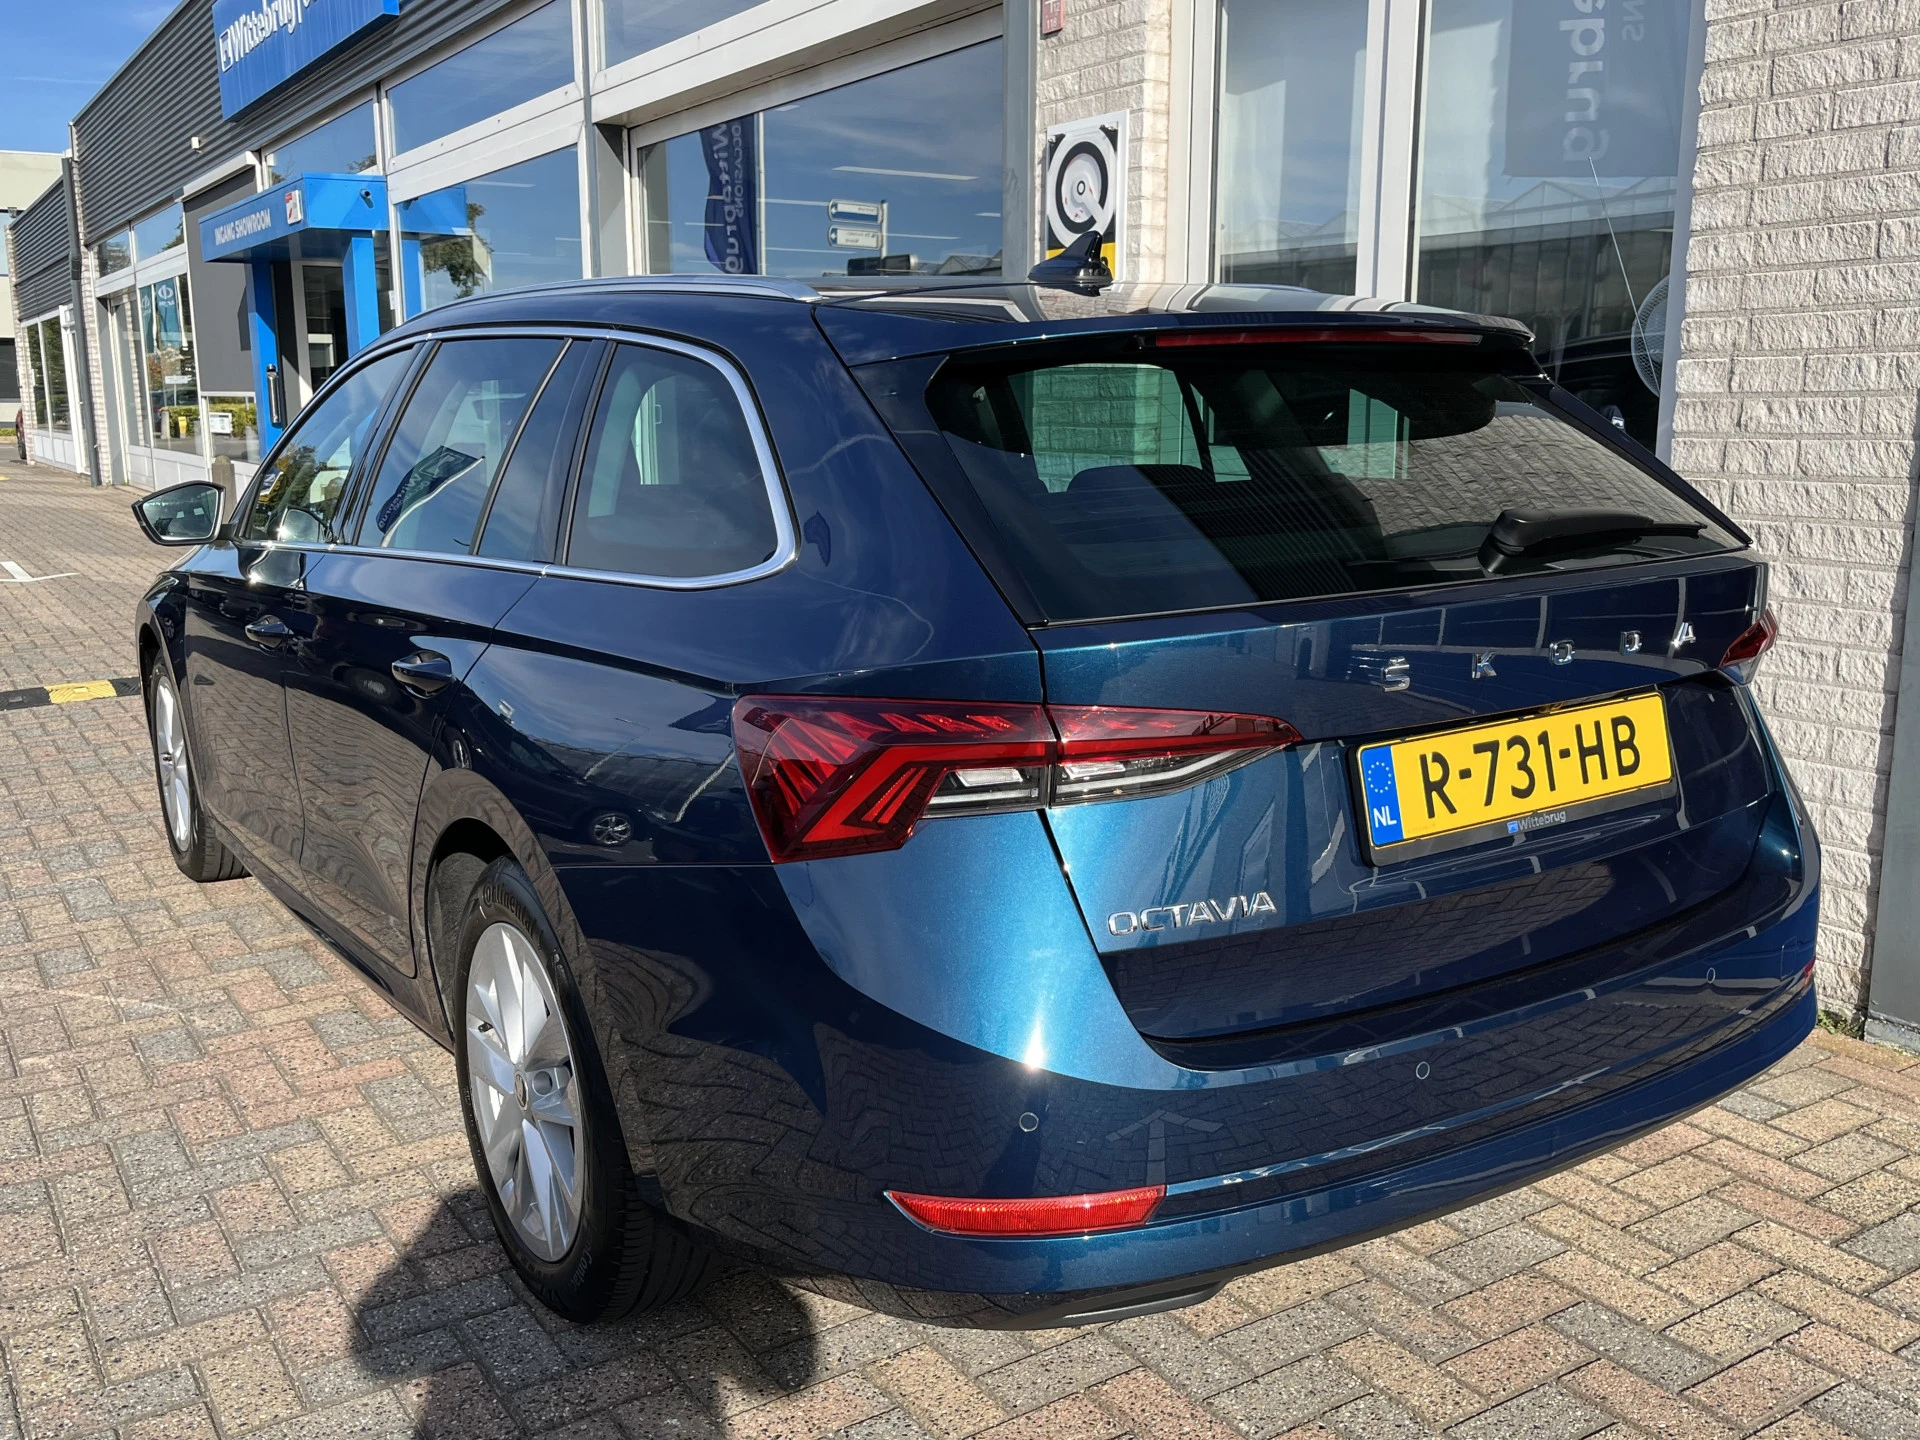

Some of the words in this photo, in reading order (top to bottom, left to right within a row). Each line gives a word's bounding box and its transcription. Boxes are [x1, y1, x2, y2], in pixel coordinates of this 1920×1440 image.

[230, 0, 297, 62] Wittebrug
[214, 221, 236, 246] INGANG
[235, 207, 272, 239] SHOWROOM
[1417, 714, 1642, 820] R-731-HB
[1372, 804, 1398, 829] NL
[1517, 810, 1567, 831] Wittebrug
[1107, 891, 1278, 937] OCTAVIA
